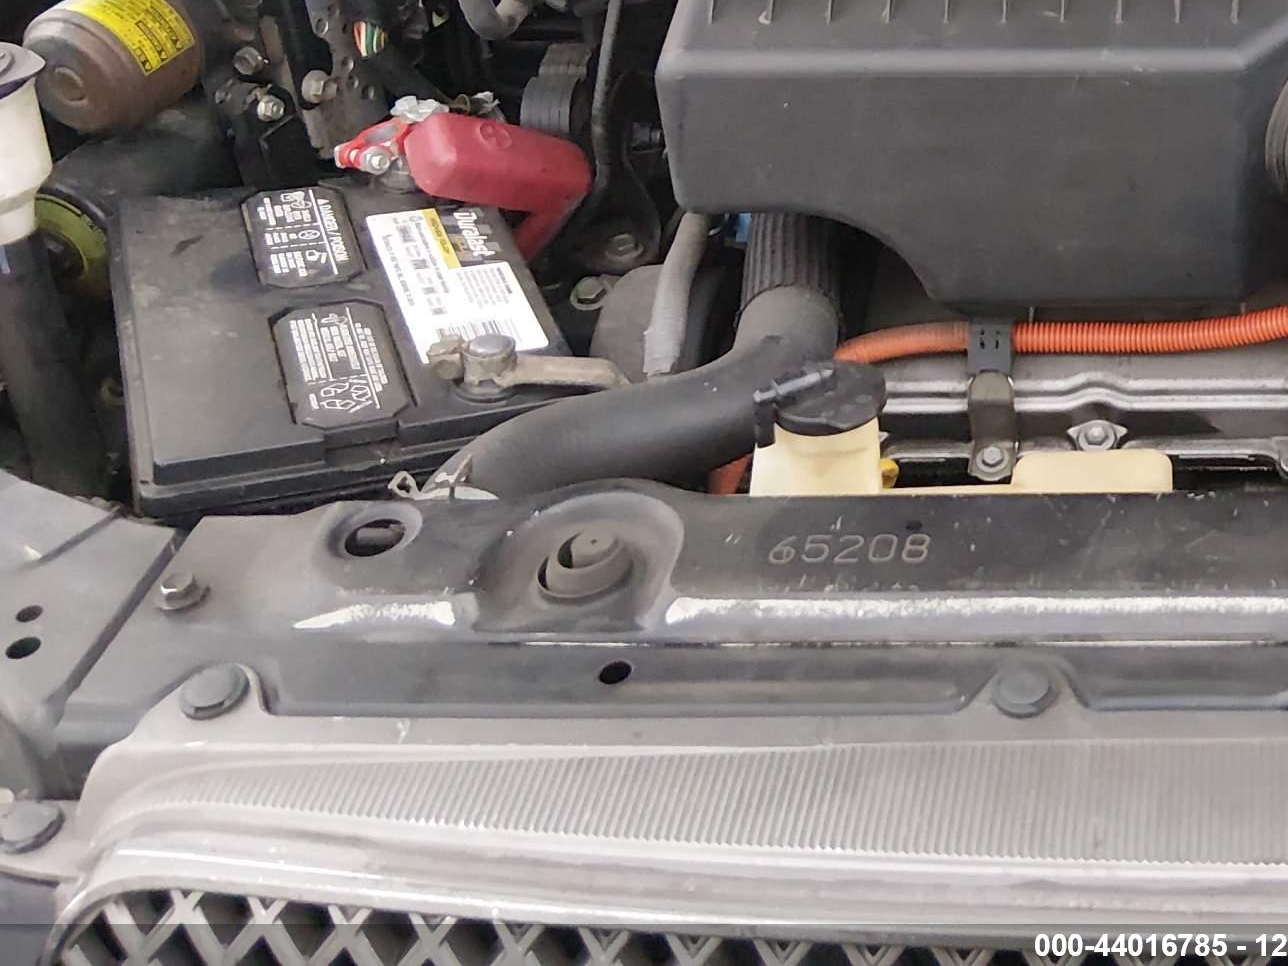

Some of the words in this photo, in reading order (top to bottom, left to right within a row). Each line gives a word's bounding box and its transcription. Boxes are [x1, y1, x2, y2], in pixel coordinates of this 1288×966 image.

[318, 203, 339, 232] DANGER
[329, 235, 350, 262] POISON
[452, 211, 497, 258] Duralast
[767, 533, 932, 564] 65208
